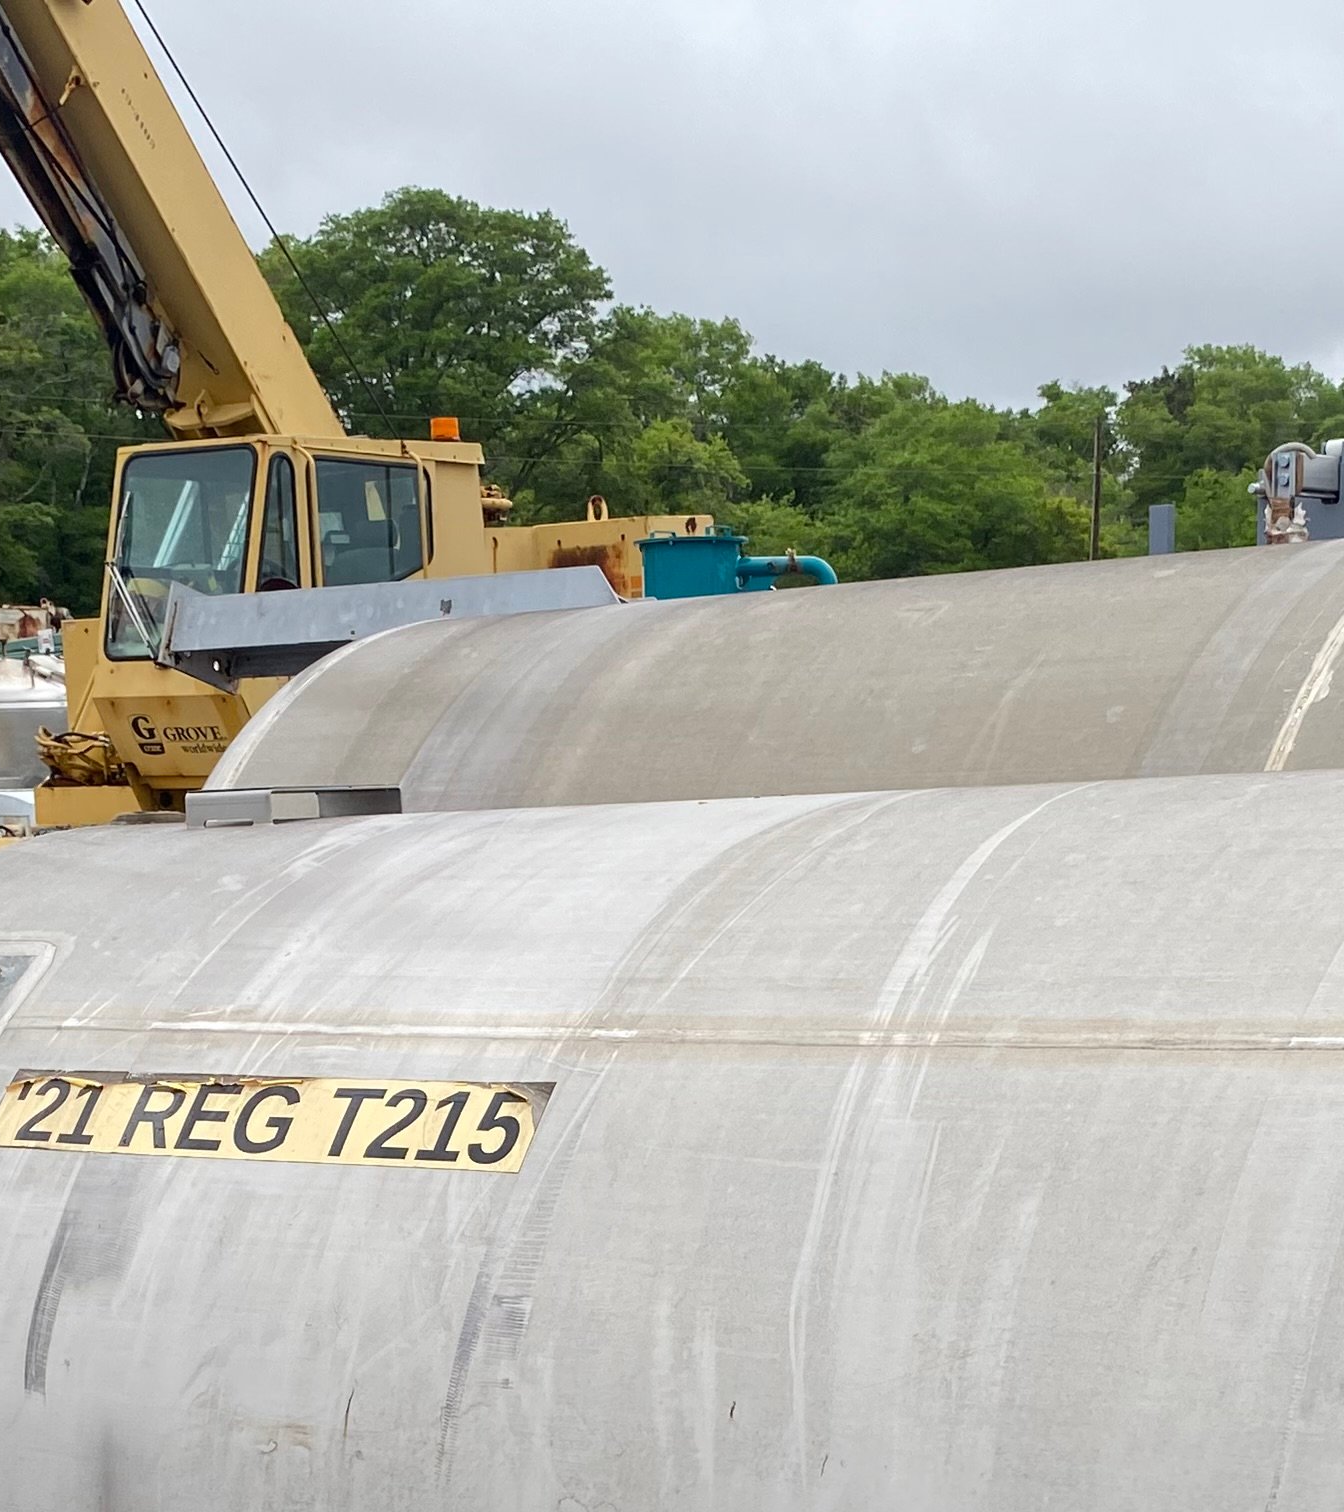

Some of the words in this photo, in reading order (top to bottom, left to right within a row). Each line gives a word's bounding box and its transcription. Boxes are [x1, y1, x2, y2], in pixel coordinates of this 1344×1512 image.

[131, 716, 156, 740] G
[163, 726, 222, 741] GROVE
[120, 1082, 301, 1154] REG
[328, 1086, 533, 1165] T215
